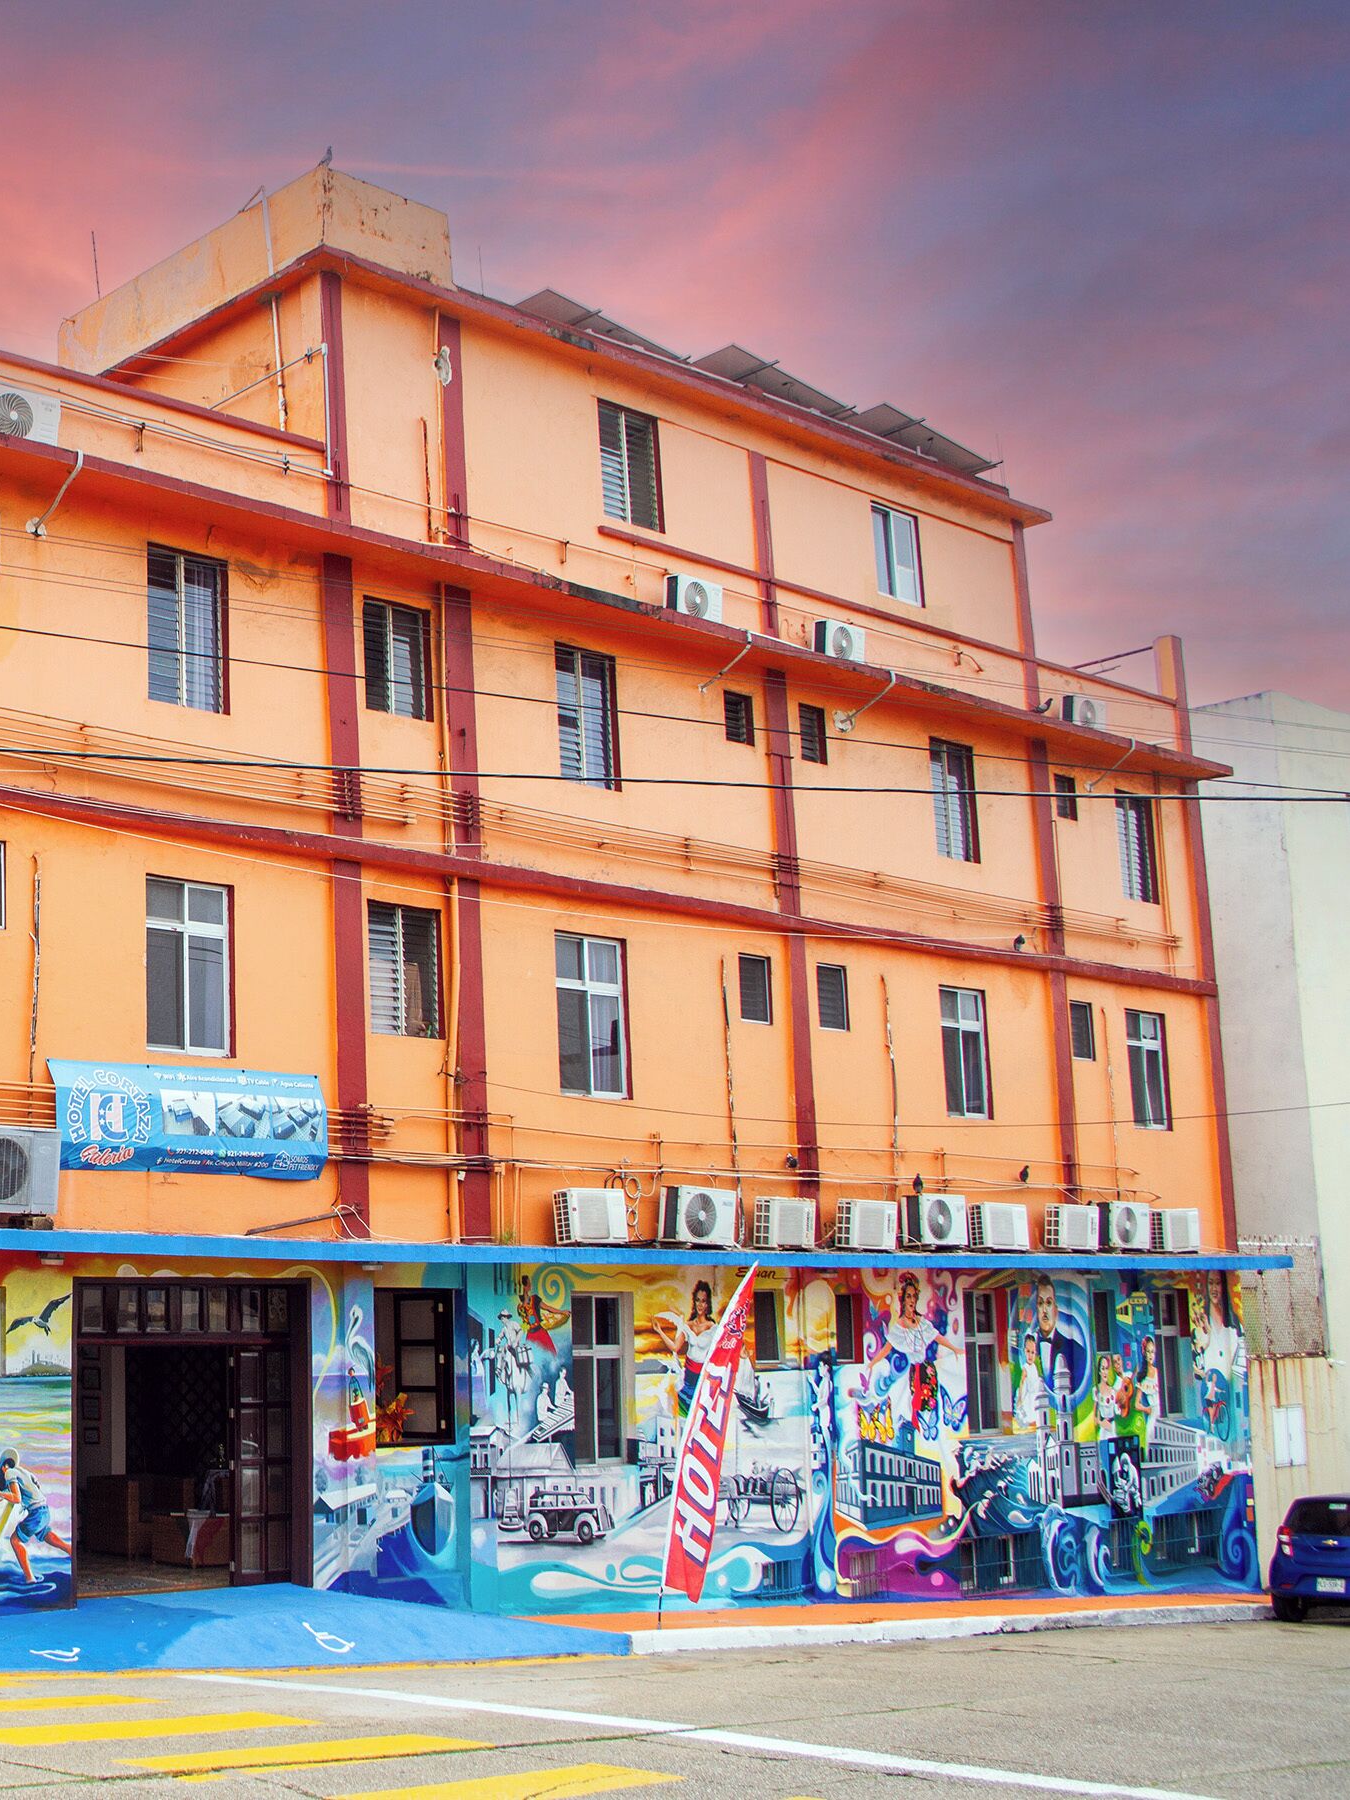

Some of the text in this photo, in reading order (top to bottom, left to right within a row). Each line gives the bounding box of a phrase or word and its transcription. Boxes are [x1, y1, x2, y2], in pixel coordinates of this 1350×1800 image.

[67, 1069, 151, 1144] HOTEL CORTAZA
[675, 1361, 733, 1568] HOTEL
